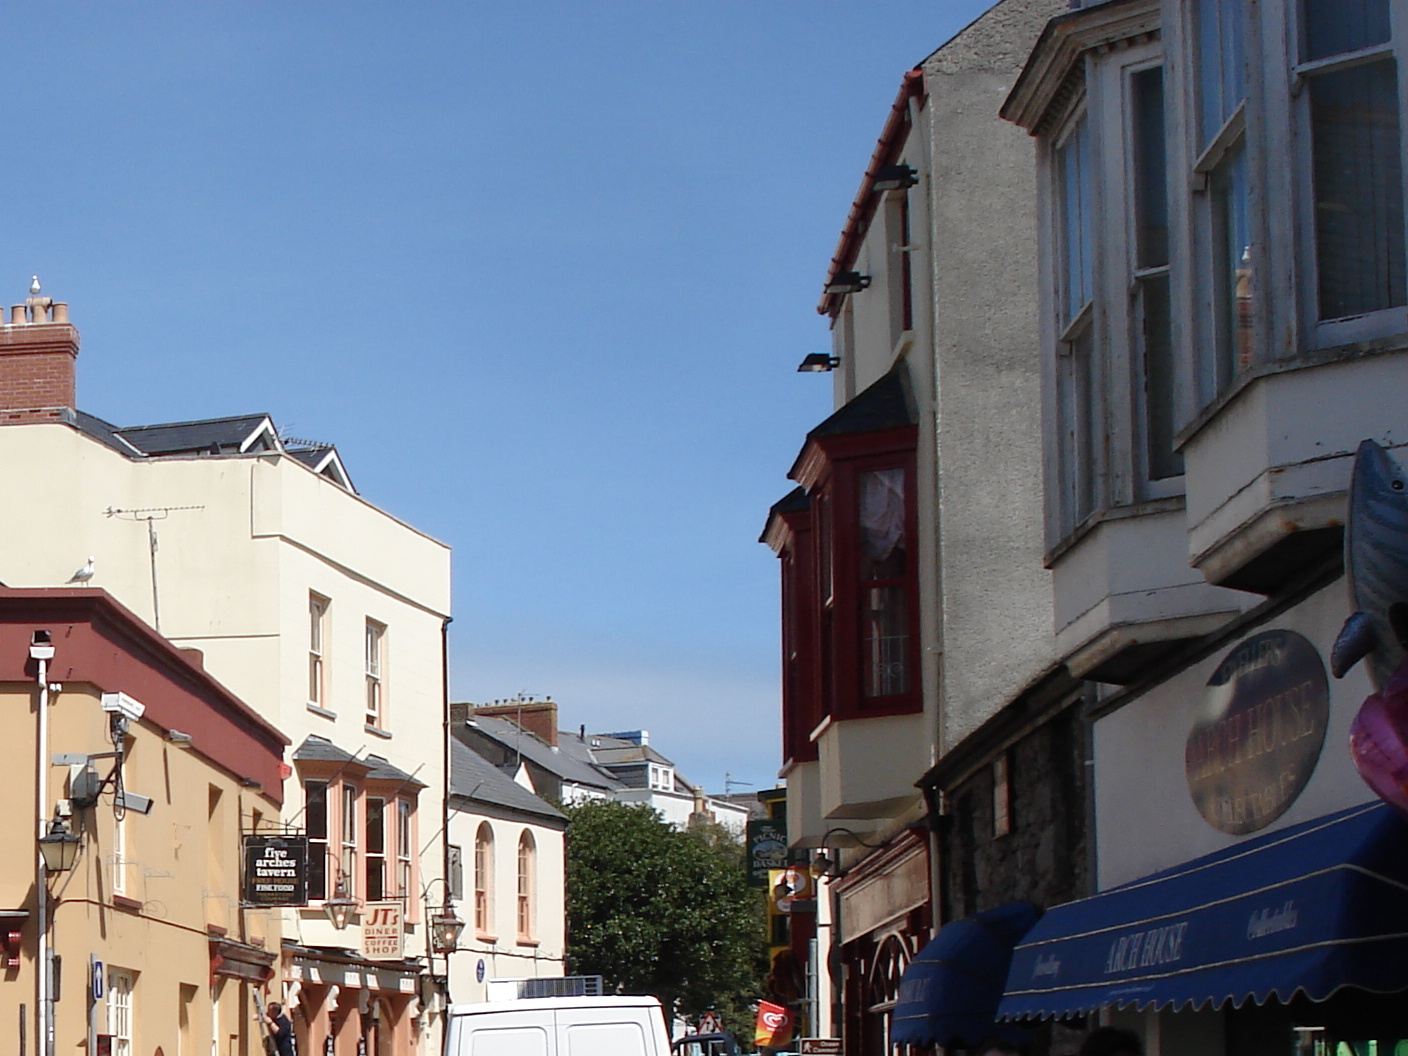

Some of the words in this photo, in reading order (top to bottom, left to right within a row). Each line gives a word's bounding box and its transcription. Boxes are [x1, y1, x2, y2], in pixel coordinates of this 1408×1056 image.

[264, 847, 288, 858] five
[255, 857, 296, 867] arches
[256, 868, 296, 877] tavern
[365, 908, 399, 926] JT's
[1104, 931, 1145, 974] ARCH
[1140, 921, 1190, 967] HOUSE
